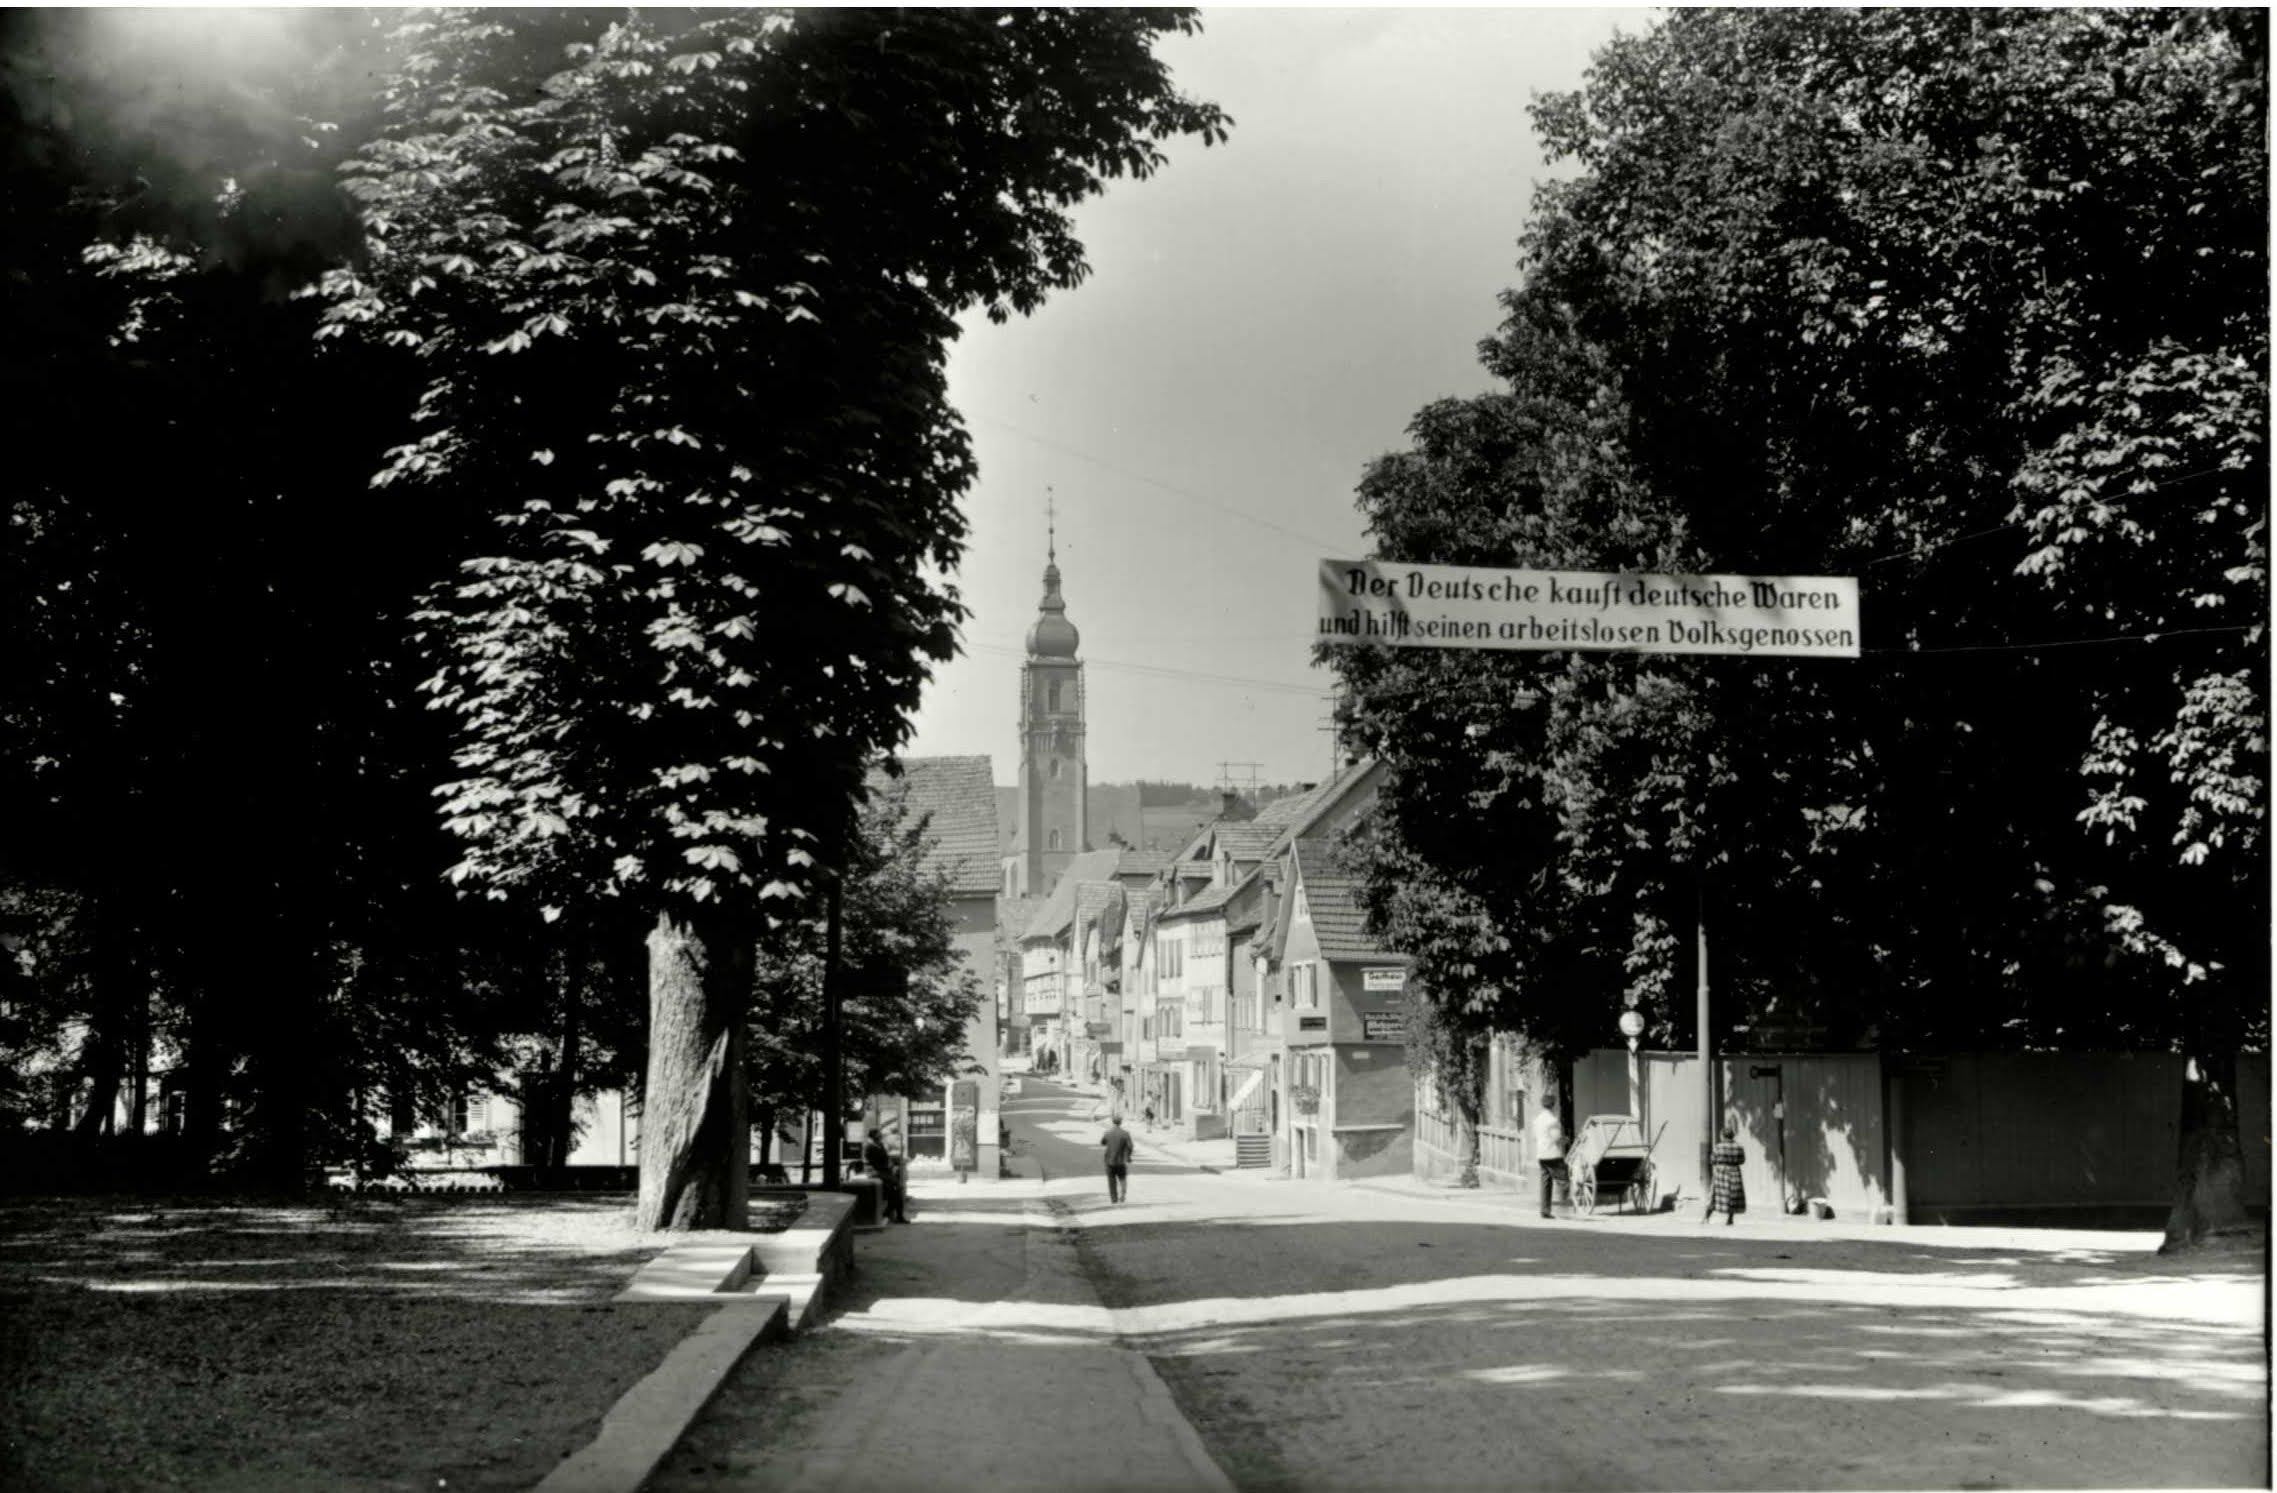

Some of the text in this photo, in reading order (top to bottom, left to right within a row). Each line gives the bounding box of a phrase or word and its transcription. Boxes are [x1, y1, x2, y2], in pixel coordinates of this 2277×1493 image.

[1346, 568, 1841, 611] Der Deutsche kauft deutsche Waren
[1319, 608, 1854, 651] und hilft seinen arbeitslosen Volksgenossen
